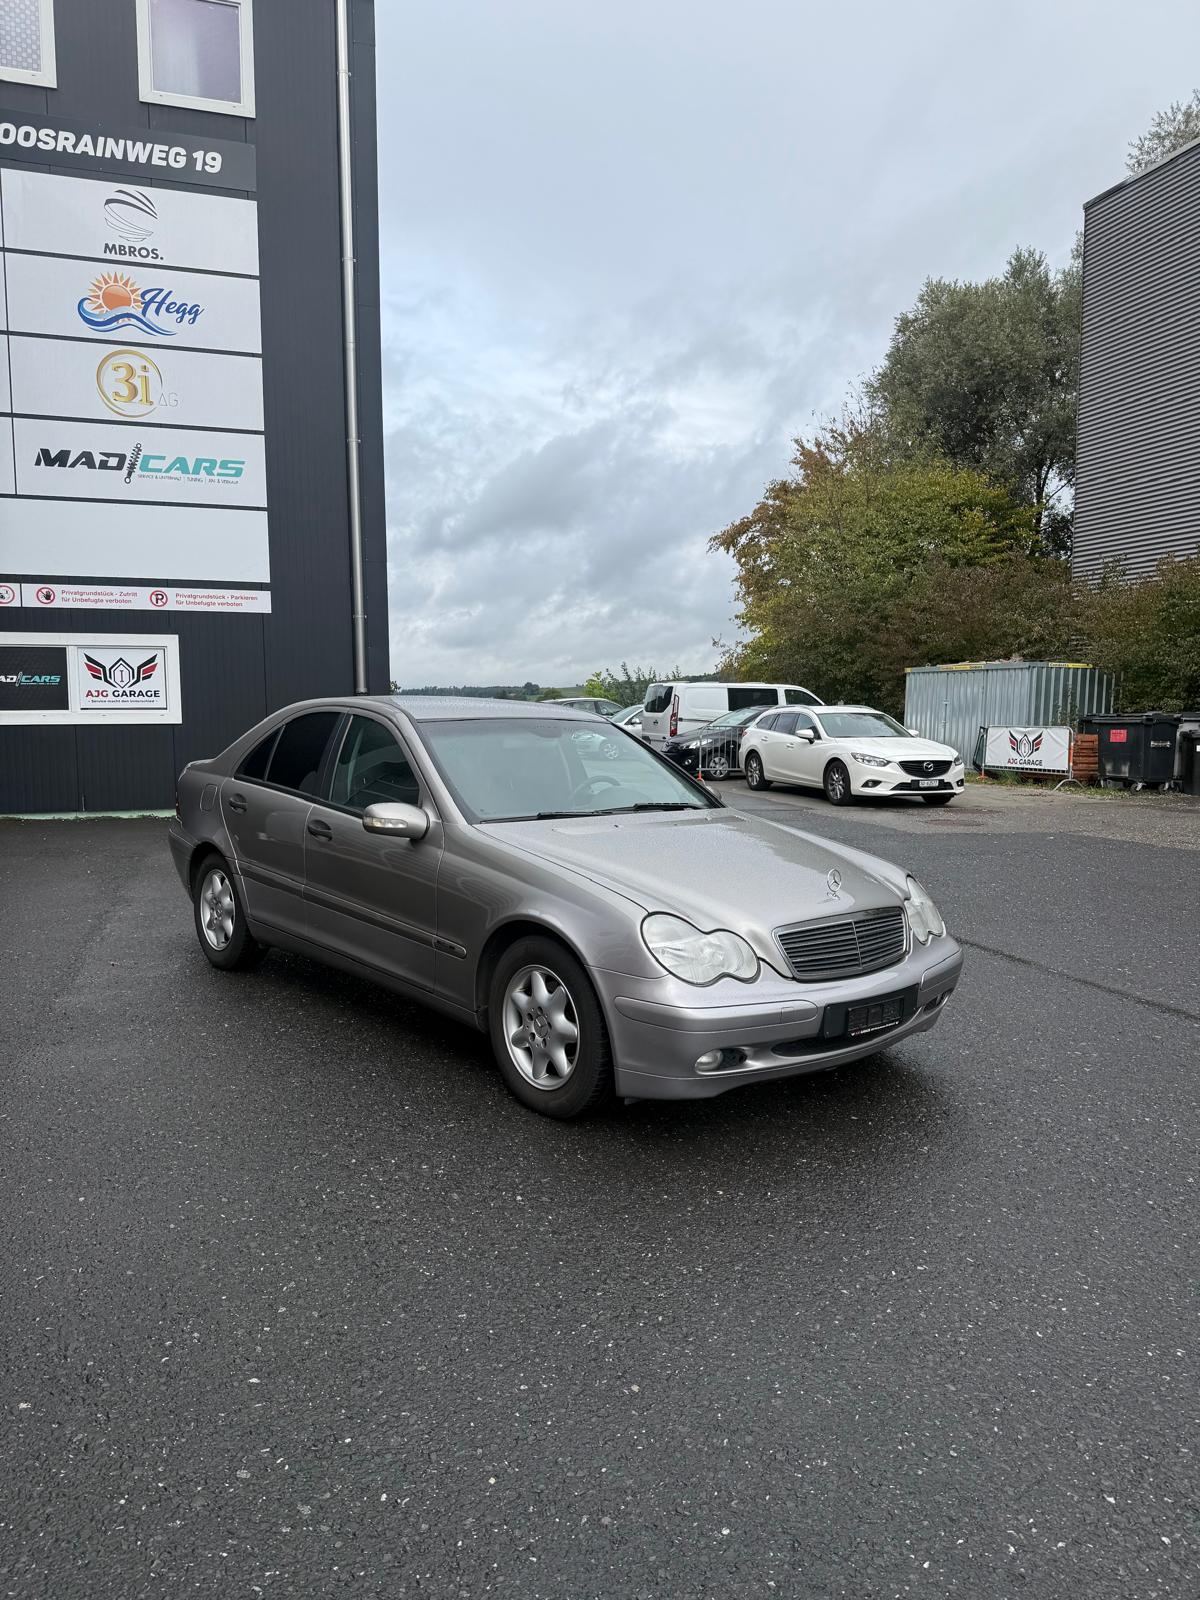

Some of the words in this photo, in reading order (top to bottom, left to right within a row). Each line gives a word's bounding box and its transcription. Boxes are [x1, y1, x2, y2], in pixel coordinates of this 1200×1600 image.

[0, 122, 187, 169] OOSRAINWEG
[192, 149, 223, 174] 19
[103, 242, 164, 261] MBROS.
[140, 287, 205, 325] Hegg
[34, 448, 127, 471] MAD
[139, 454, 246, 478] CARS
[61, 589, 114, 598] Privatgrundstück
[175, 593, 226, 601] Privatgrundstück
[21, 675, 61, 683] CARS
[85, 690, 109, 698] AJG
[112, 690, 161, 698] GARAGE
[1019, 758, 1043, 766] GARAGE
